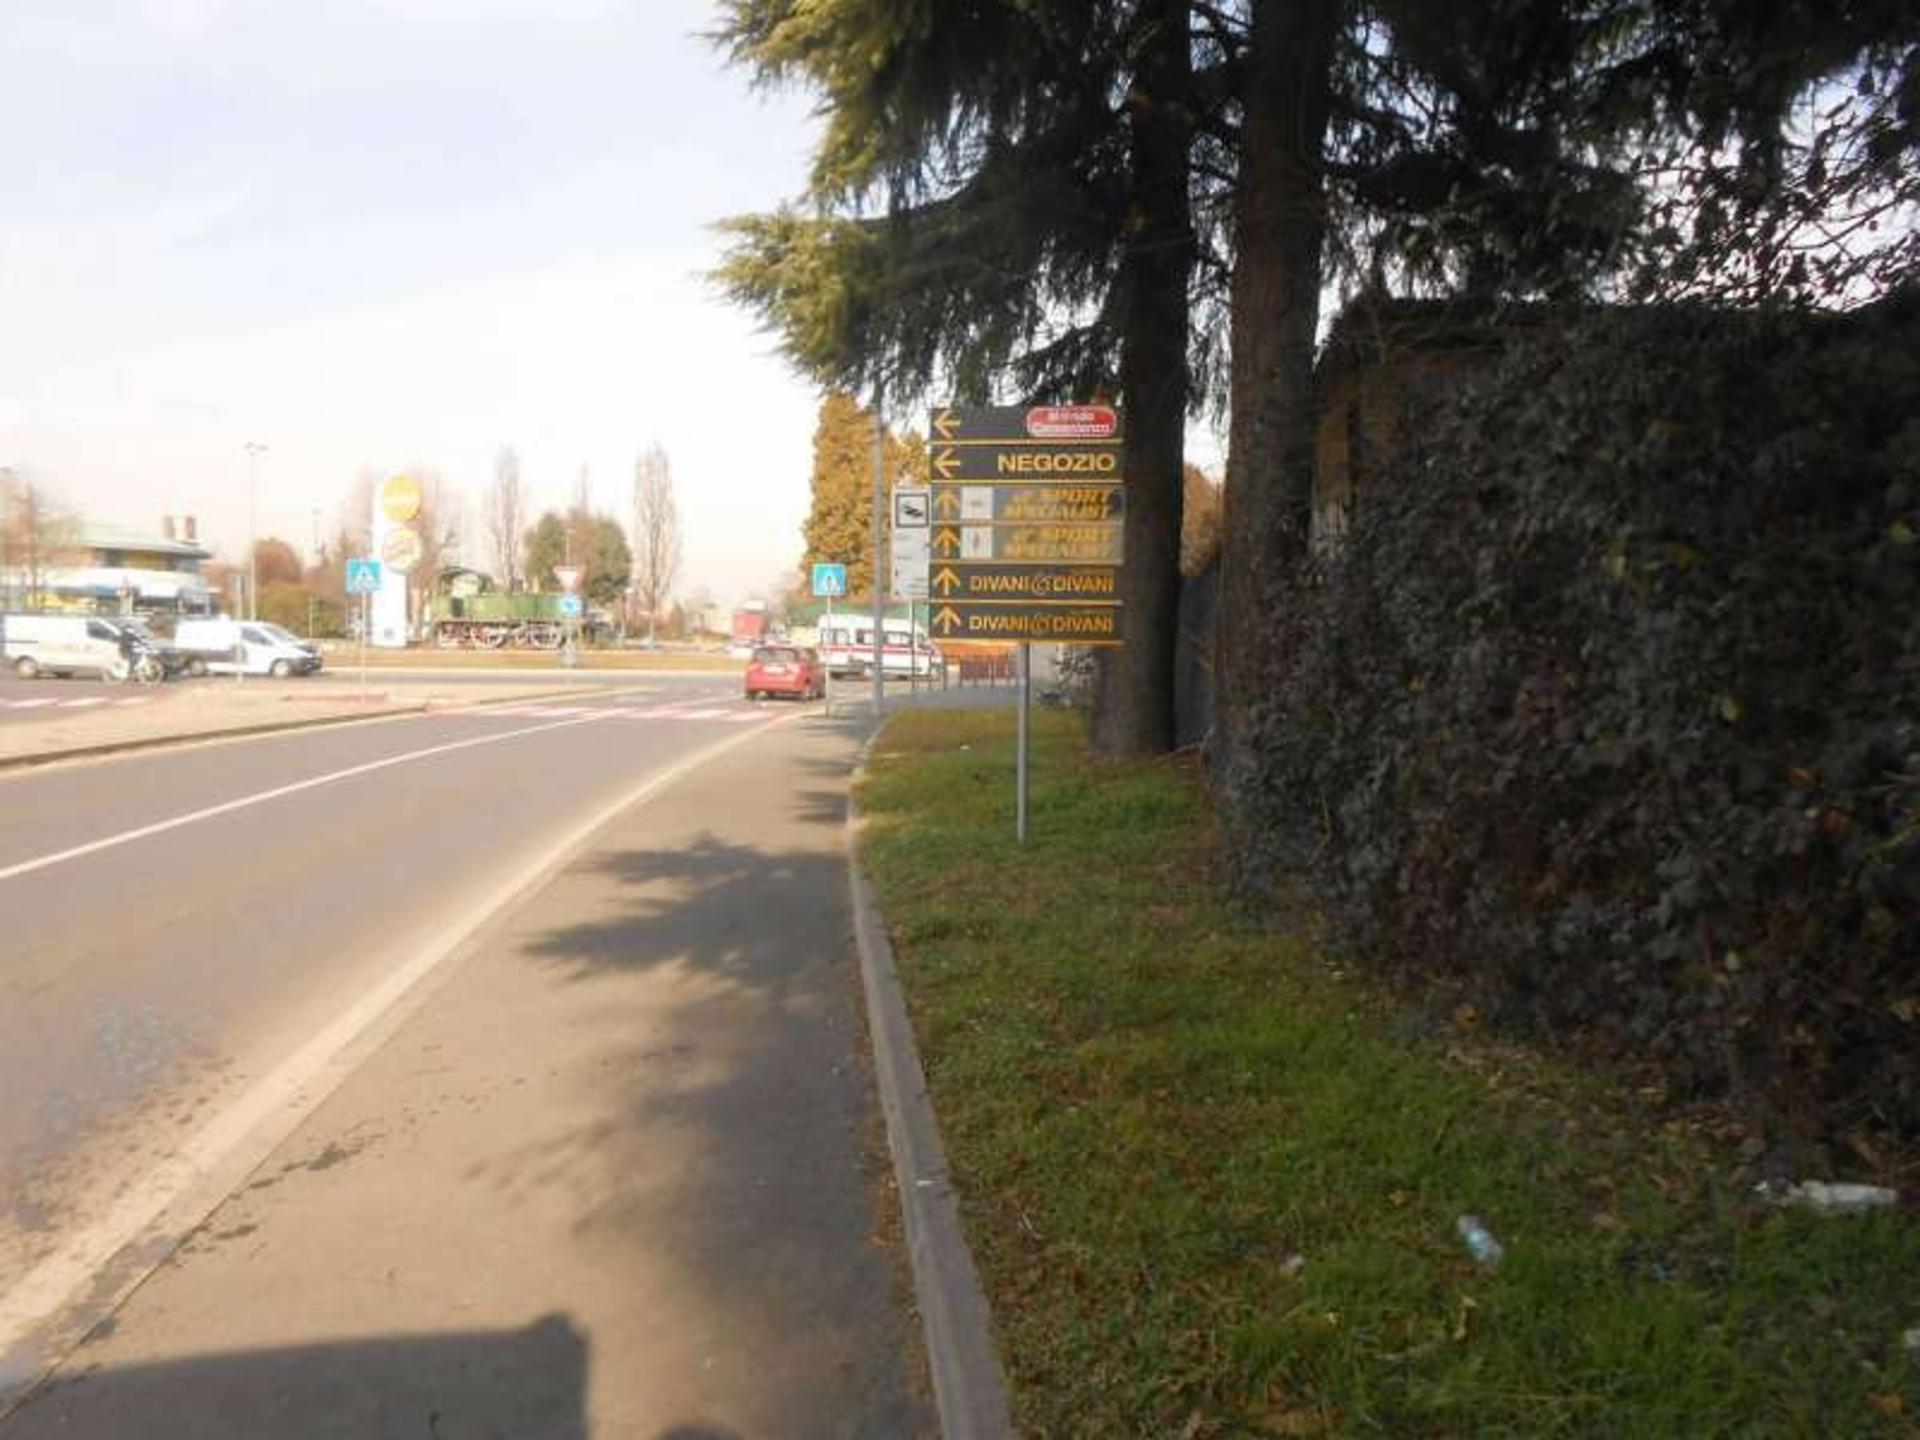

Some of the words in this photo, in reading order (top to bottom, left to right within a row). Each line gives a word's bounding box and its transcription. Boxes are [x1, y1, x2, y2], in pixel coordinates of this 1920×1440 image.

[998, 453, 1115, 472] NEGOZIO
[970, 575, 1029, 591] DIVANI
[1053, 575, 1114, 592] DIVANI
[968, 615, 1028, 632] DIVANI
[1053, 616, 1114, 633] DIVANI
